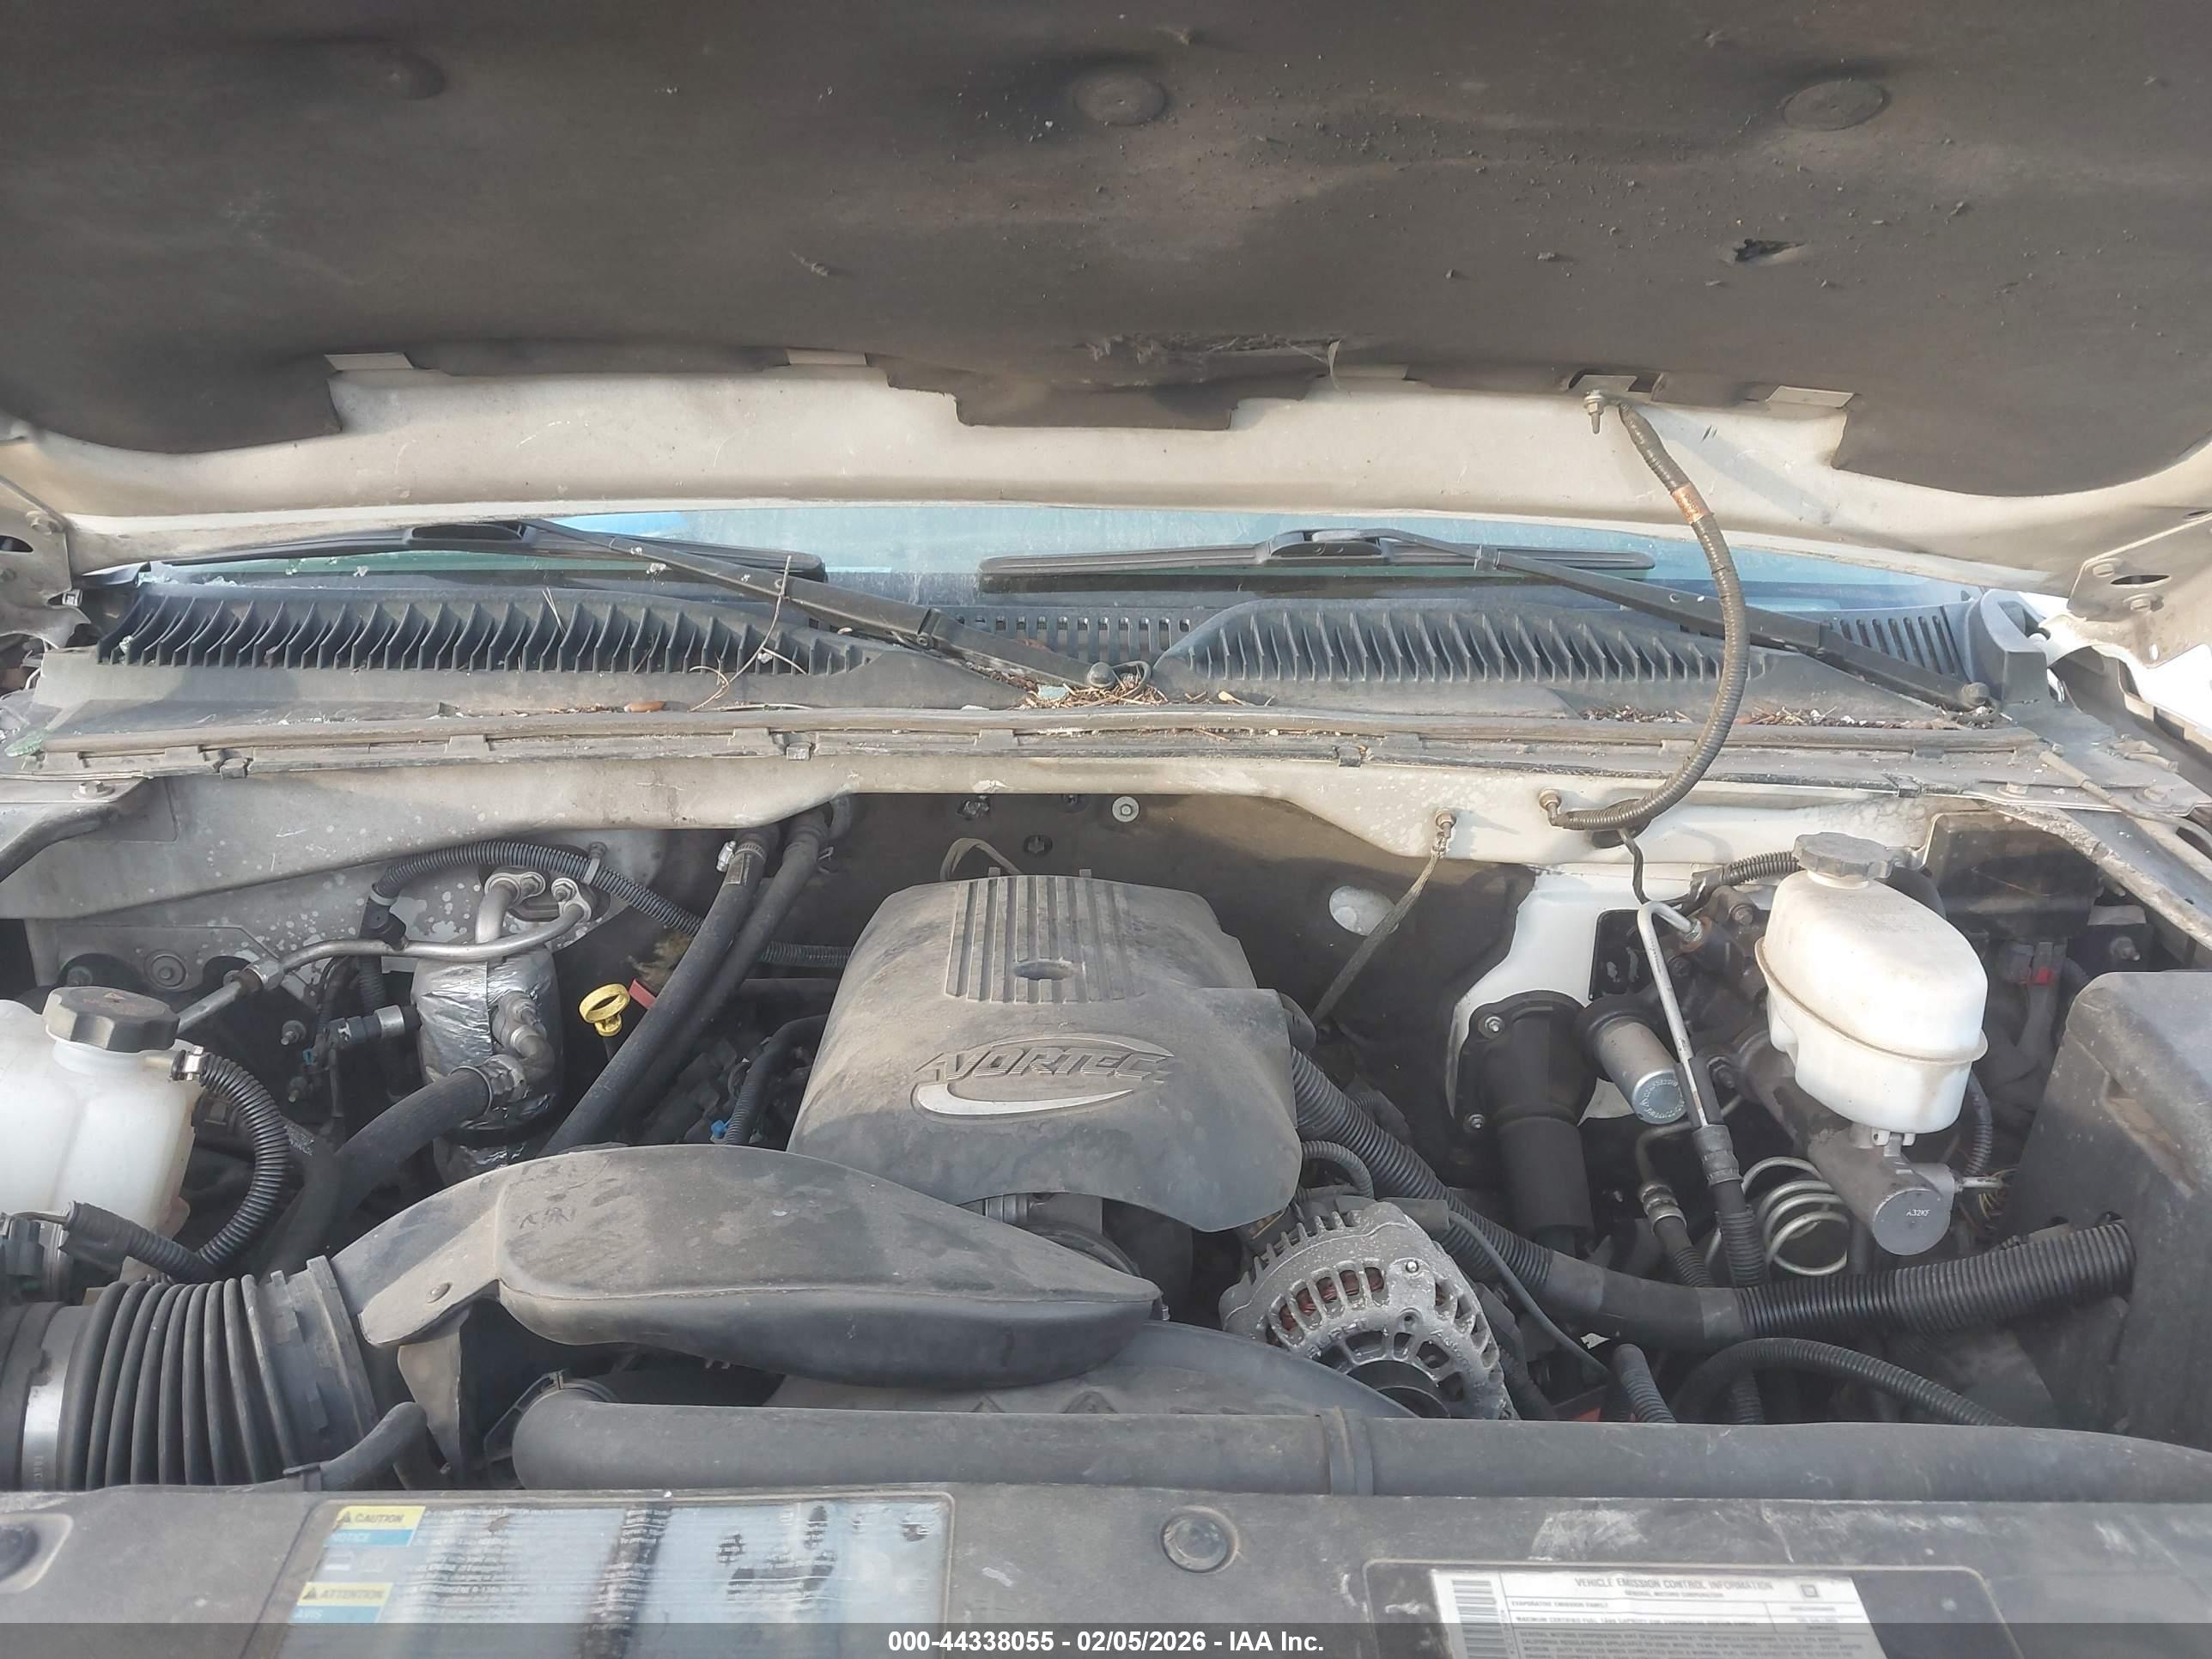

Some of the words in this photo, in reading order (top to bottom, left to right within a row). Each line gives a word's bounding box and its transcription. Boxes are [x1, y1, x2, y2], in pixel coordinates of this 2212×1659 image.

[941, 1045, 1167, 1080] VORTEC
[355, 1512, 405, 1523] CAUTION
[330, 1531, 371, 1542] NOTICE
[1574, 1577, 1613, 1588] VEHICLE
[1615, 1577, 1662, 1589] EMISSION
[1663, 1579, 1706, 1589] CONTROL
[1708, 1579, 1774, 1591] INFORMATION
[321, 1589, 384, 1600] ATTENTION
